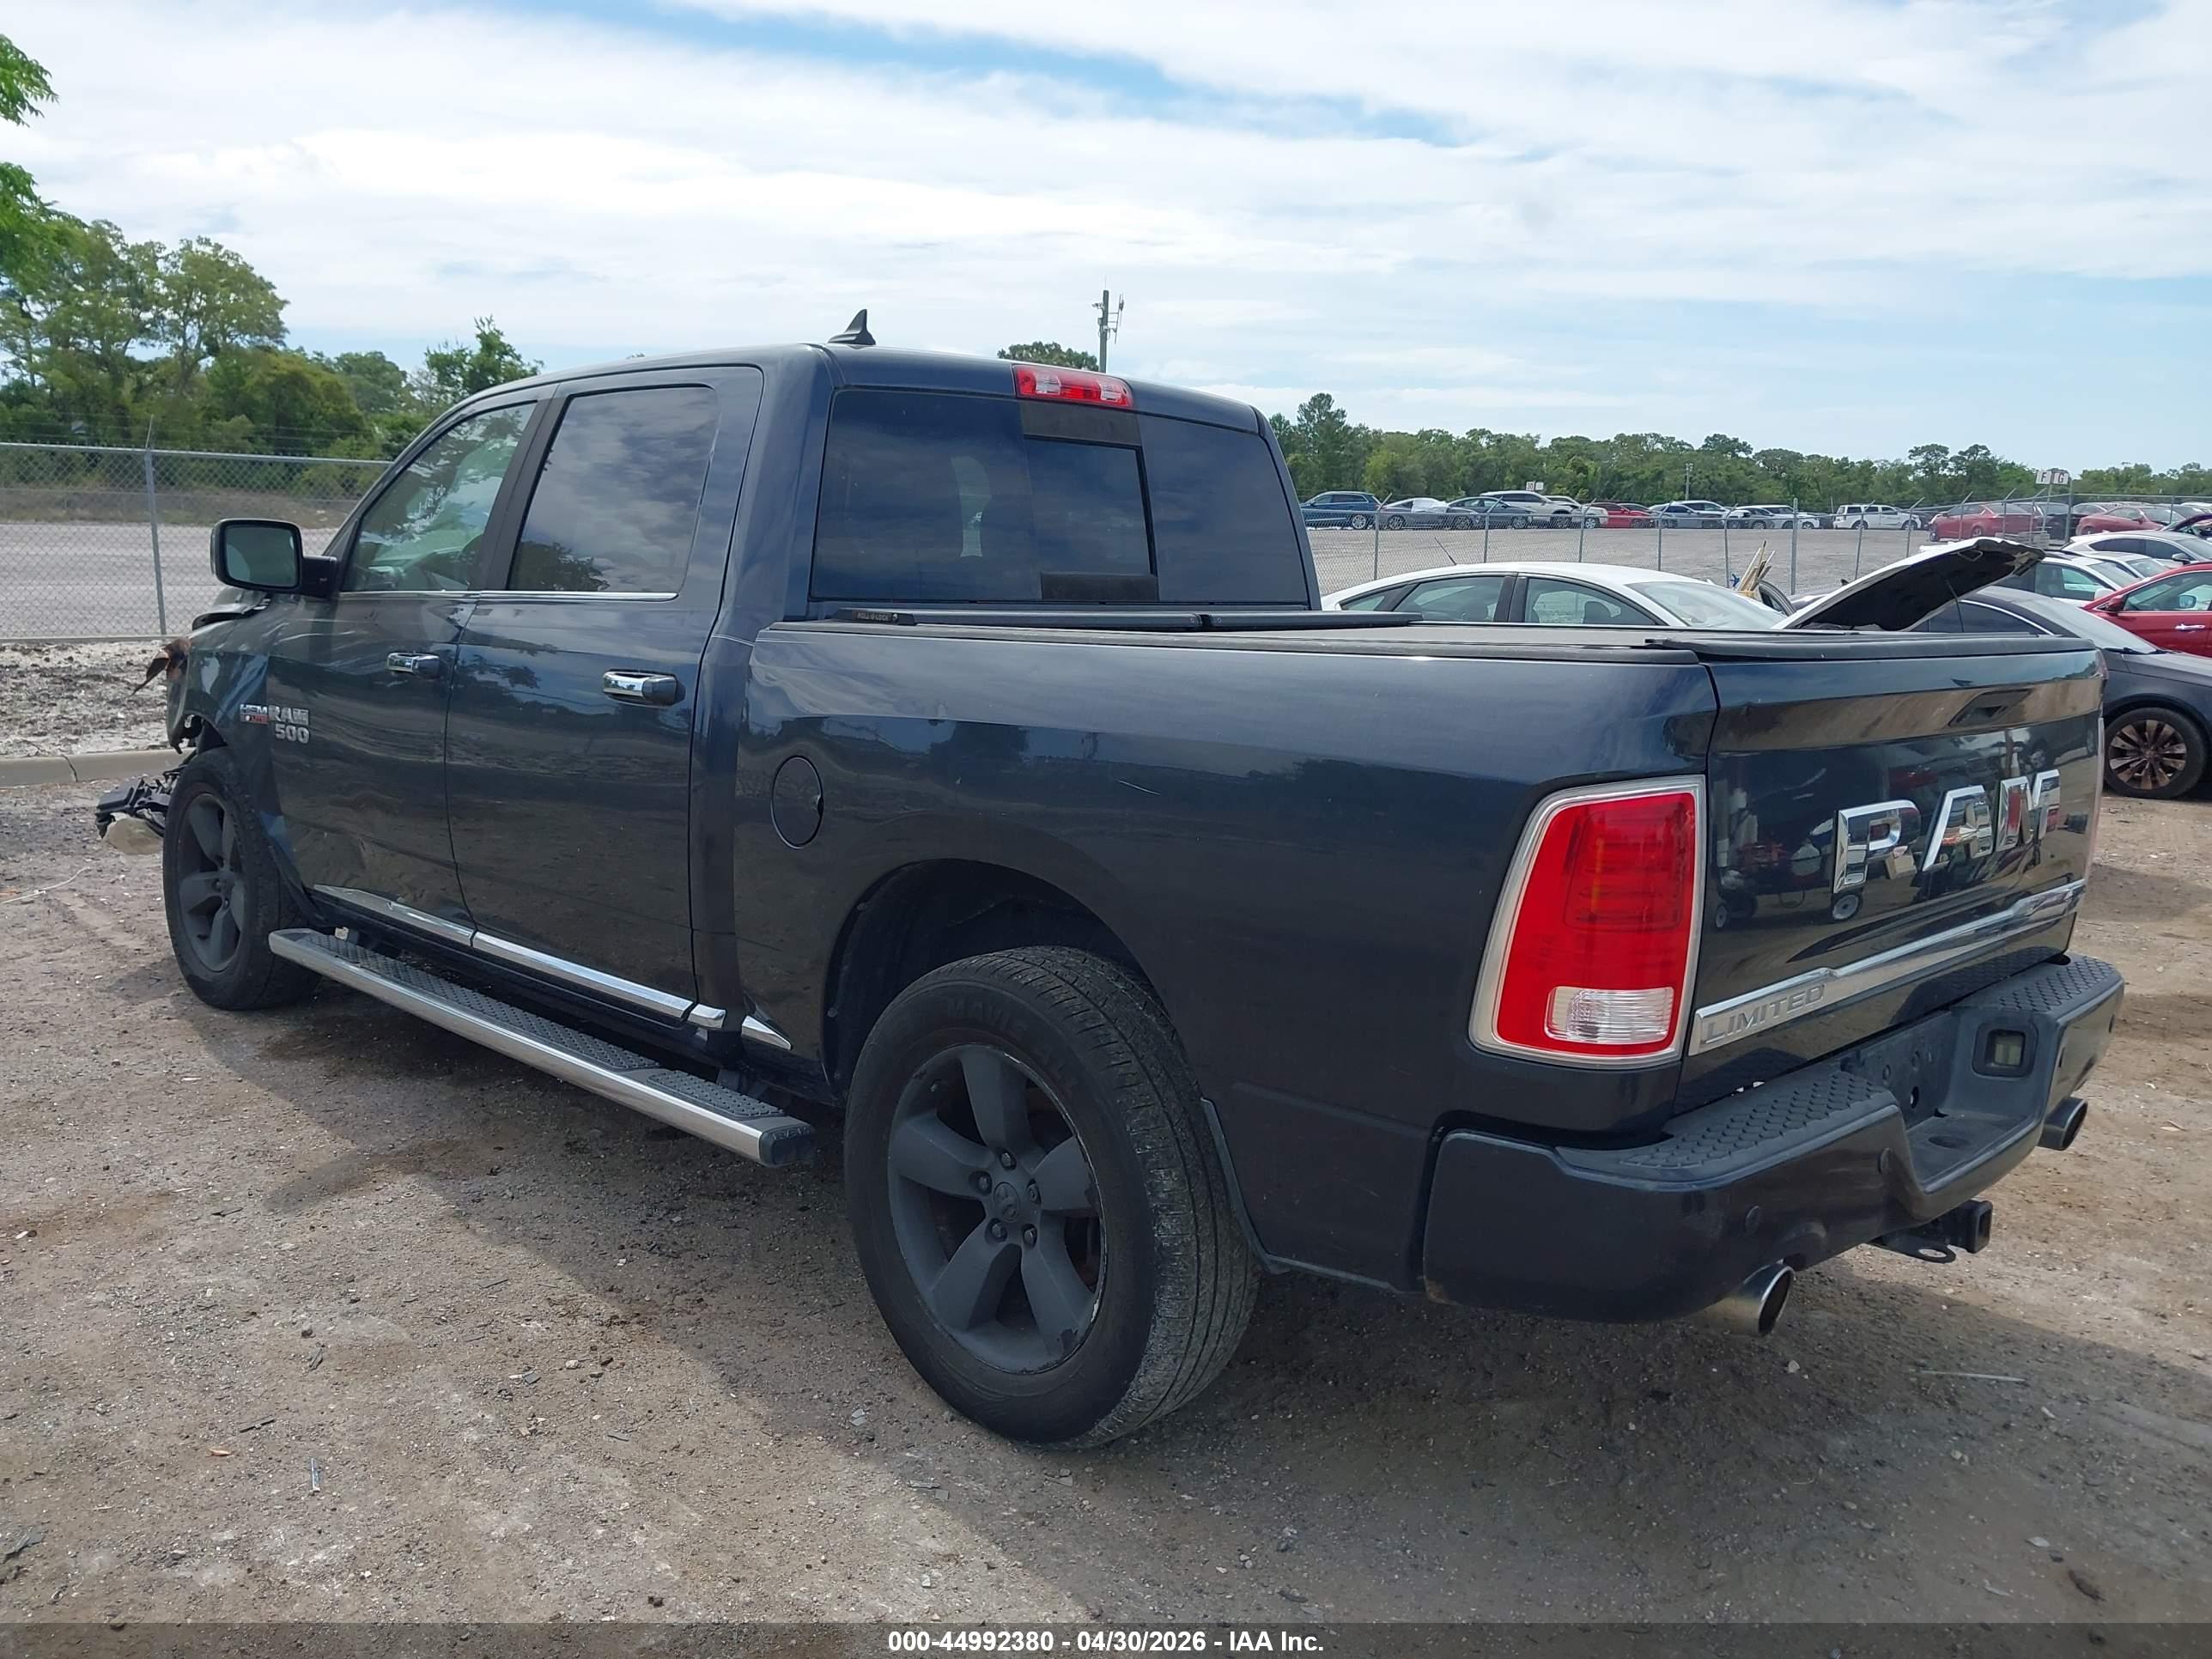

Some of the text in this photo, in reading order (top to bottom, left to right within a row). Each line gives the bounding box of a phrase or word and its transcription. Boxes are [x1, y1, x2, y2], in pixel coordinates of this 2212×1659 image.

[2040, 471, 2048, 483] F
[2057, 472, 2065, 483] G
[268, 704, 309, 726] RAM
[1832, 769, 2060, 895] RAM
[1701, 983, 1826, 1045] LIMITED
